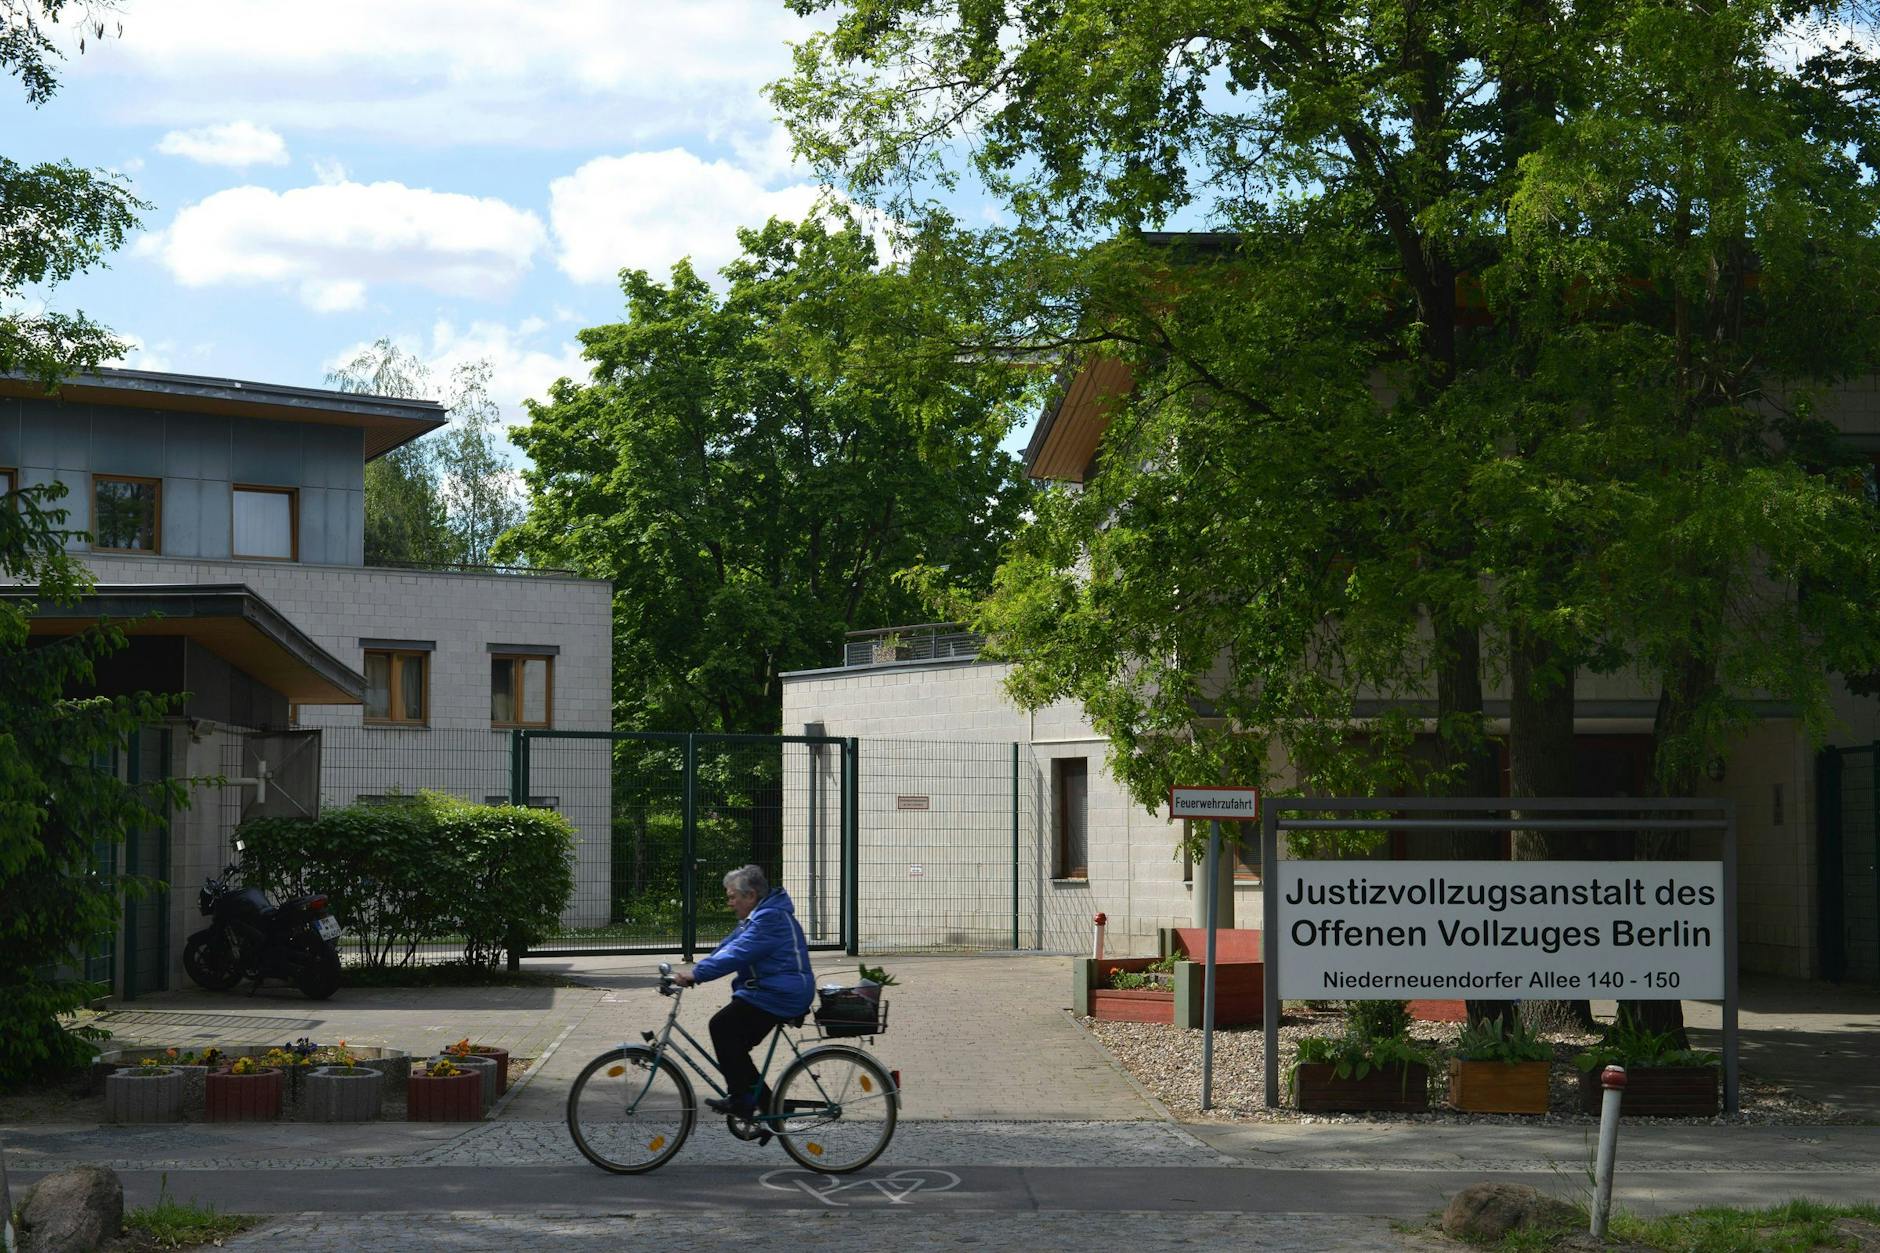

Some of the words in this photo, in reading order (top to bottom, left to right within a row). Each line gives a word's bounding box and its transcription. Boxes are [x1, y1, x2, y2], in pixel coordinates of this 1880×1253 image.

[1175, 797, 1252, 810] Feuerwehrzufahrt
[1286, 878, 1646, 912] Justizvollzugsanstalt
[1655, 879, 1715, 906] des
[1291, 919, 1427, 947] Offenen
[1437, 919, 1600, 954] Vollzuges
[1611, 919, 1711, 947] Berlin
[1323, 971, 1523, 989] Niederneuendorfer
[1529, 971, 1581, 989] Allee
[1588, 971, 1625, 989] 140
[1642, 971, 1681, 989] 150
